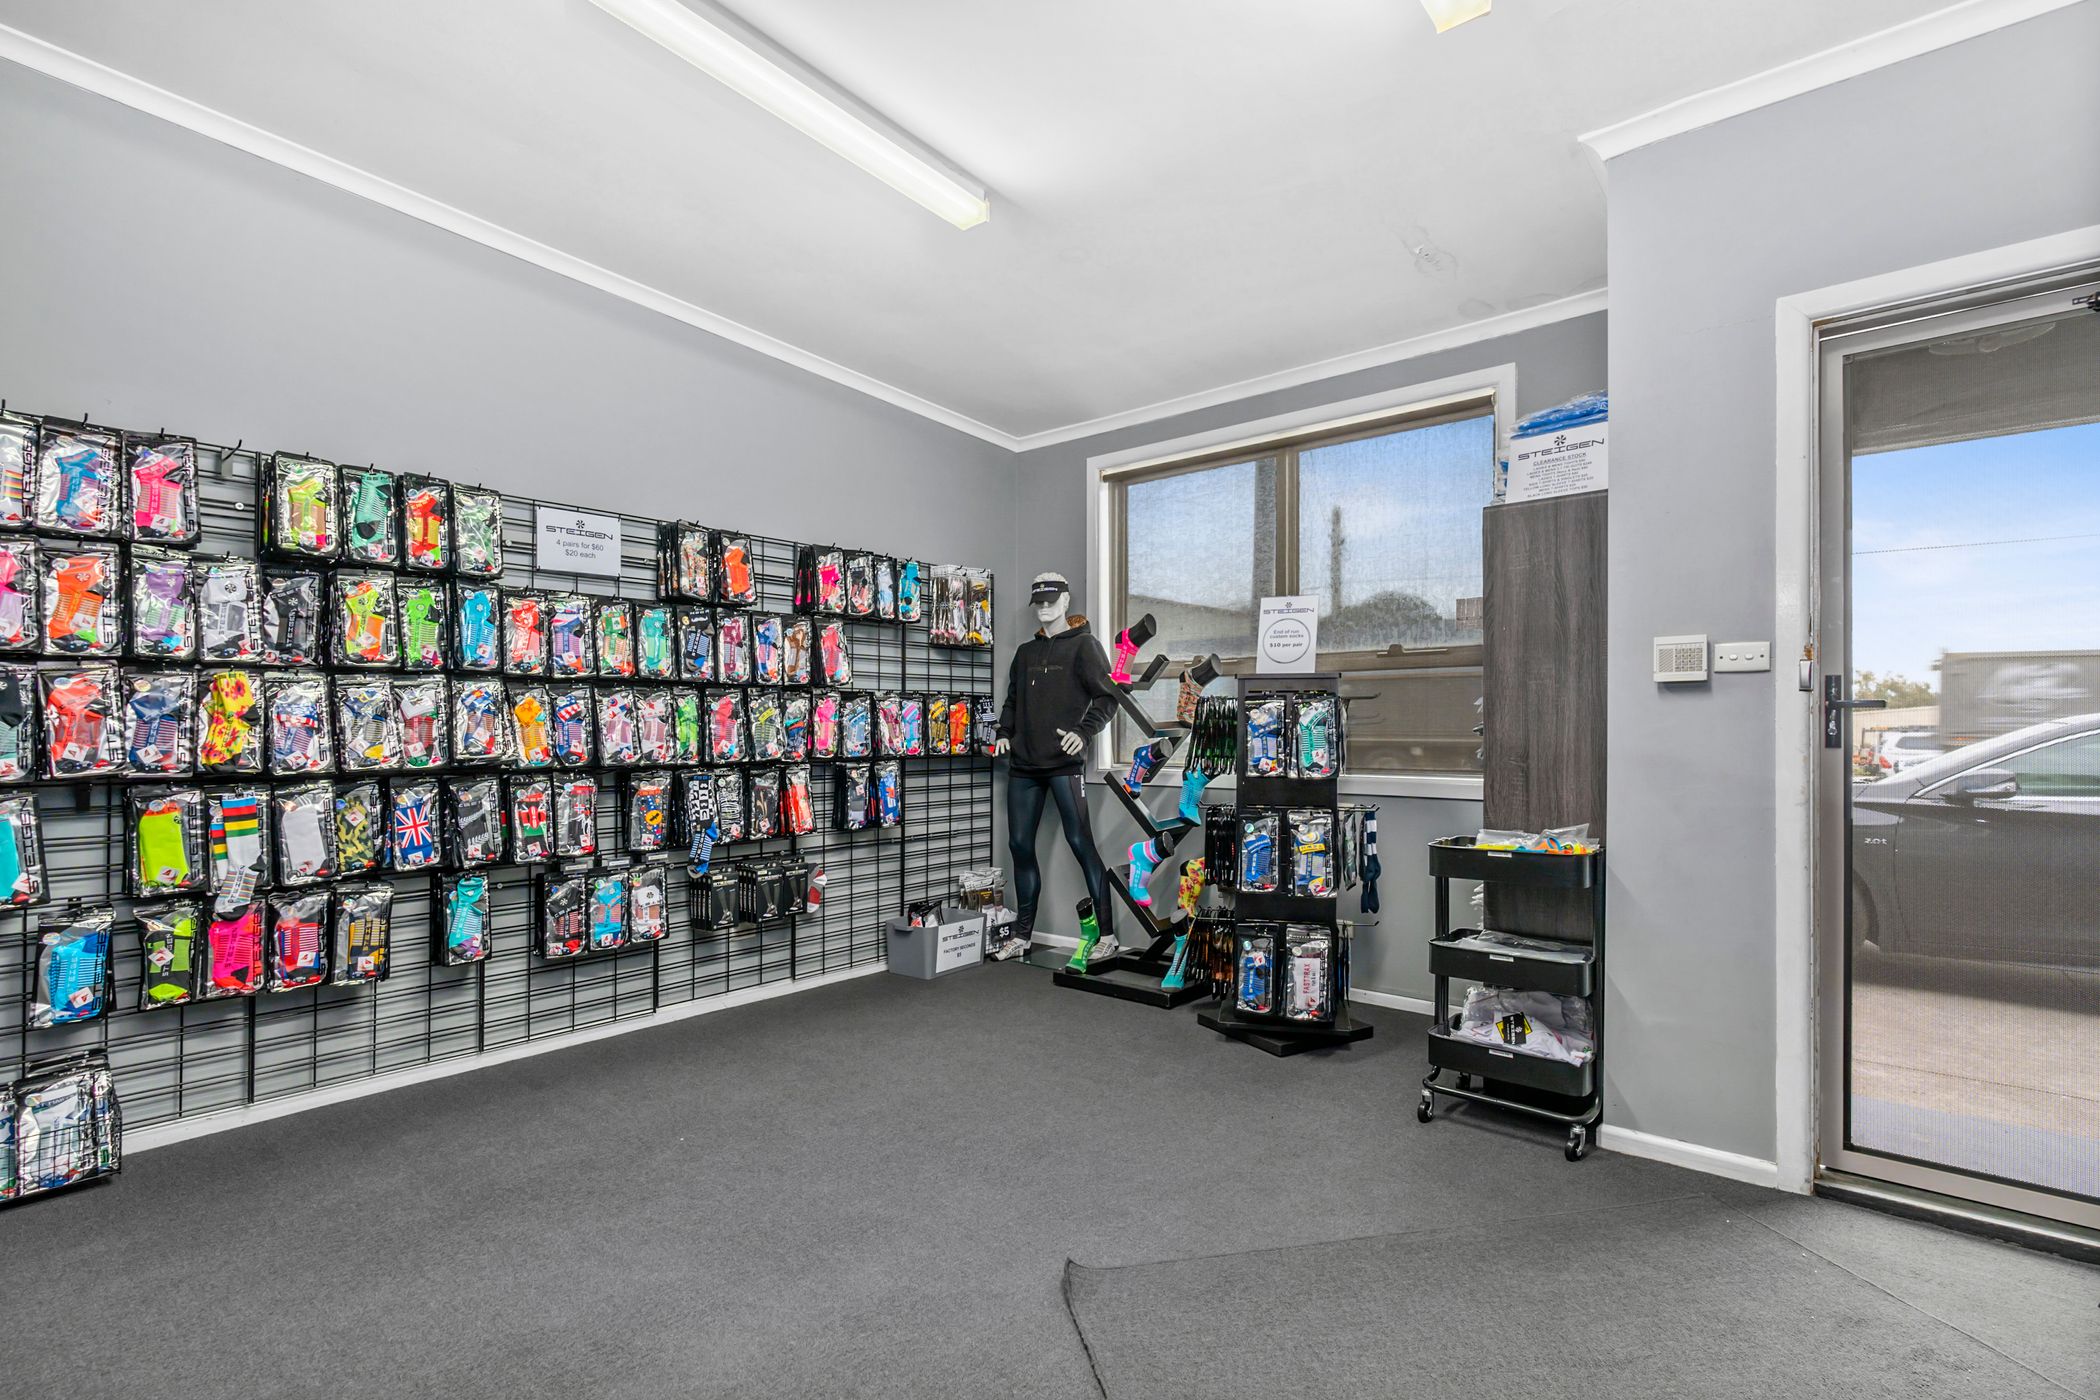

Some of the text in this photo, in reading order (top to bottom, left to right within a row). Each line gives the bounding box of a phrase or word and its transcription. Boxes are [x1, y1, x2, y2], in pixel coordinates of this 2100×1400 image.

[1518, 438, 1605, 461] STEIGEN
[1533, 452, 1587, 467] CLEARANCE STOCK
[546, 525, 614, 541] STEIGEN
[562, 540, 580, 549] pairs
[565, 548, 597, 559] $20 each
[246, 566, 260, 650] STEIGEN
[286, 608, 297, 648] STEIGEN
[187, 793, 201, 881] STEIGEN
[320, 785, 335, 867] STEIGEN
[20, 798, 39, 894] STEIGEN
[253, 901, 263, 985] STEIGEN
[942, 930, 980, 942] STEIGEN
[999, 926, 1010, 937] $5
[162, 934, 173, 977] STGEN
[1303, 963, 1311, 994] FASTTRAX
